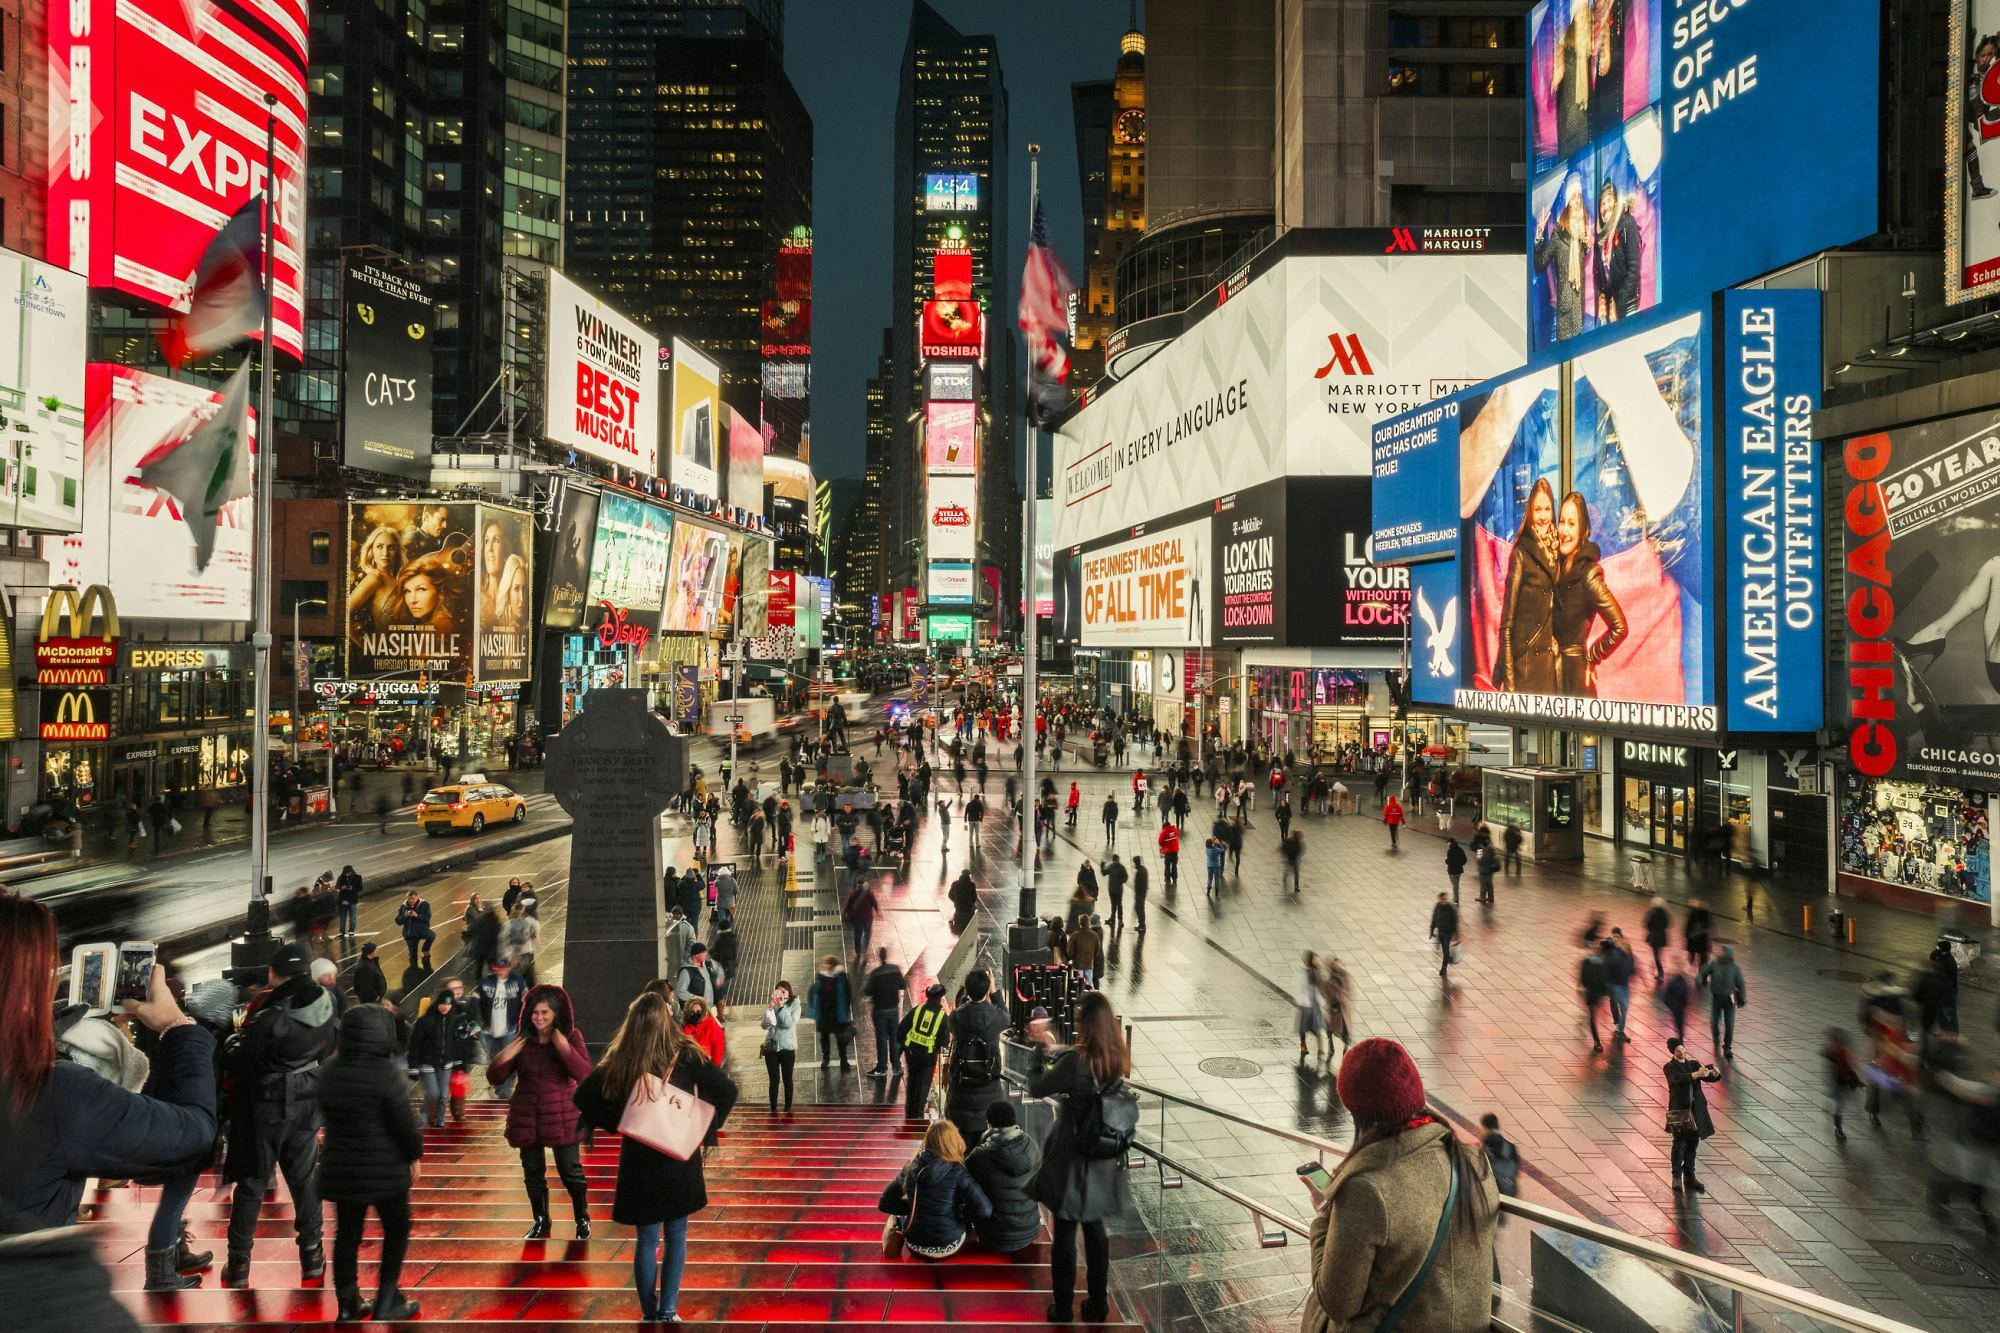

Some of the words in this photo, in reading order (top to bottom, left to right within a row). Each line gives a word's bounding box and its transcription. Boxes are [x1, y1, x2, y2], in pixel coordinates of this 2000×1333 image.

[1673, 39, 1714, 89] OF
[1673, 55, 1757, 132] FAME
[934, 179, 969, 193] 4:54
[1424, 229, 1491, 238] MARRIOTT
[1424, 241, 1483, 249] MARQUIS
[364, 265, 380, 278] IT'S
[381, 271, 403, 287] BACK
[404, 281, 420, 293] AND
[1228, 264, 1250, 286] MARRIOTT
[385, 282, 408, 297] THAN
[575, 304, 642, 368] WINNER!
[577, 336, 583, 350] 6
[585, 339, 607, 364] TONY
[608, 354, 640, 382] AWARDS
[923, 346, 979, 356] TOSHIBA
[365, 372, 417, 406] CATS
[941, 377, 970, 386] TDK
[1328, 384, 1422, 396] MARRIOTT
[1742, 307, 1776, 455] EAGLE
[577, 360, 640, 430] BEST
[1328, 402, 1366, 414] NEW
[576, 408, 639, 456] MUSICAL
[1375, 427, 1393, 443] OUR
[1394, 411, 1442, 437] DREAMTRIP
[1444, 401, 1458, 419] TO
[1067, 455, 1110, 496] WELCOME
[1114, 451, 1124, 473] IN
[1128, 426, 1162, 466] EVERY
[1167, 379, 1248, 447] LANGUAGE
[1375, 441, 1392, 461] NYC
[1393, 436, 1410, 455] HAS
[1411, 428, 1437, 450] COME
[1375, 459, 1398, 478] TRUE!
[1885, 473, 1924, 510] 20
[1784, 394, 1813, 629] OUTFITTERS
[1899, 500, 1936, 527] KILLING
[1938, 498, 1948, 511] IT
[1375, 527, 1396, 540] SIMONE
[1396, 522, 1422, 536] SCHAEKS
[1375, 537, 1400, 552] HEERLEN,
[1400, 535, 1413, 546] THE
[1413, 528, 1457, 543] NETHERLANDS
[1100, 549, 1138, 578] FUNNIEST
[1140, 538, 1184, 570] MUSICAL
[1224, 540, 1258, 574] LOCK
[1259, 536, 1273, 568] IN
[1224, 573, 1246, 595] YOUR
[1246, 570, 1273, 592] RATES
[1344, 567, 1409, 589] YOUR
[1085, 584, 1104, 625] OF
[1105, 578, 1137, 624] ALL
[1250, 591, 1273, 603] CONTRACT
[1346, 590, 1398, 602] WITHOUT
[1743, 465, 1777, 719] AMERICAN
[1224, 604, 1273, 626] LOCK-DOWN
[1844, 432, 1898, 777] CHICAGO
[598, 600, 650, 661] Disney
[38, 646, 112, 656] McDonald's
[363, 633, 460, 657] NASHVILLE
[481, 634, 526, 657] NASHVILLE
[658, 636, 698, 663] FOREVER
[132, 651, 205, 668] EXPRESS
[374, 659, 407, 670] THURSDAYS
[1455, 690, 1530, 714] AMERICAN
[1533, 695, 1585, 720] EAGLE
[1589, 698, 1716, 732] OUTFITTERS
[126, 750, 157, 759] EXPRESS
[171, 745, 199, 755] EXPRESS
[1624, 741, 1688, 767] DRINK
[1907, 763, 1957, 774] TELECHARGE.COM
[1903, 819, 1913, 829] 24
